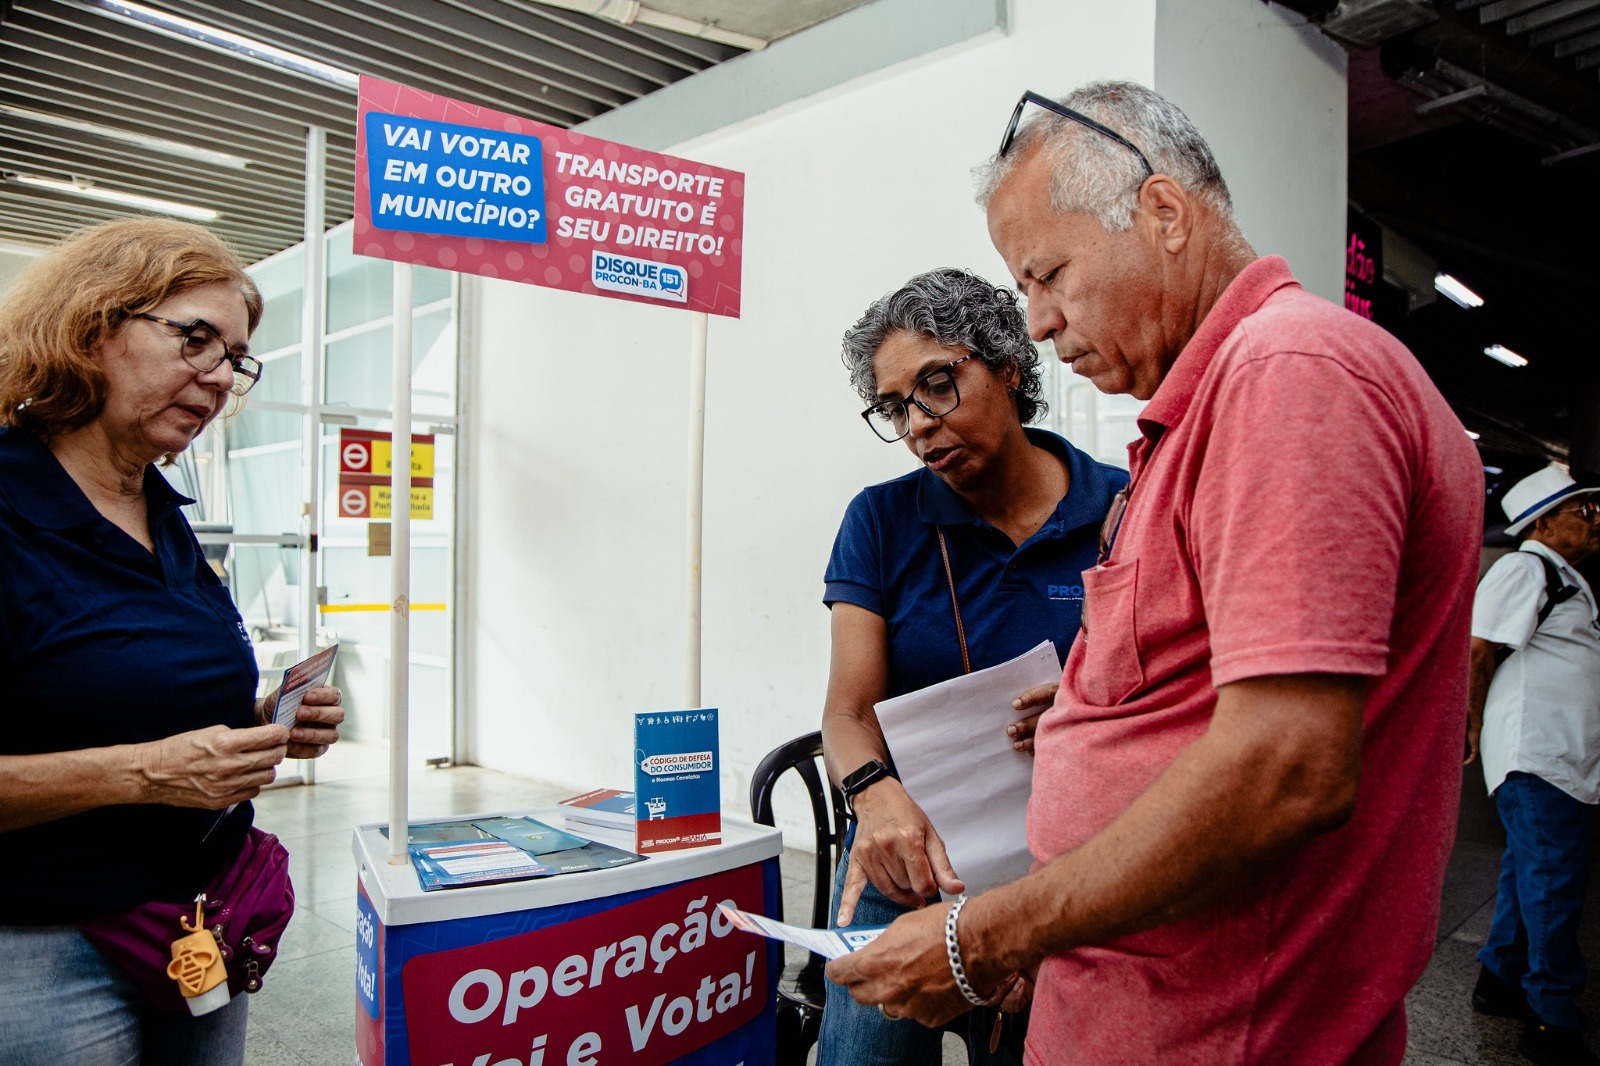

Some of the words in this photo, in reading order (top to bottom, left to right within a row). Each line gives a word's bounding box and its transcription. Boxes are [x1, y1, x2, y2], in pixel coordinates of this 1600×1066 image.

[383, 123, 431, 151] VAI
[440, 132, 530, 165] VOTAR
[383, 158, 428, 184] EM
[435, 165, 531, 197] OUTRO
[555, 150, 725, 198] TRANSPORTE
[378, 193, 540, 230] MUNICÍPIO?
[564, 185, 694, 223] GRATUITO
[699, 200, 717, 226] É
[555, 215, 611, 242] SEU
[615, 223, 725, 256] DIREITO!
[595, 255, 658, 280] DISQUE
[595, 271, 657, 290] PROCON-BA
[661, 272, 679, 286] 151
[1047, 585, 1083, 597] PRO
[650, 756, 678, 765] CÓDIGO
[650, 765, 662, 773] DO
[664, 762, 712, 772] CONSUMIDOR
[448, 896, 737, 1026] Operação
[624, 950, 756, 1053] Vota!
